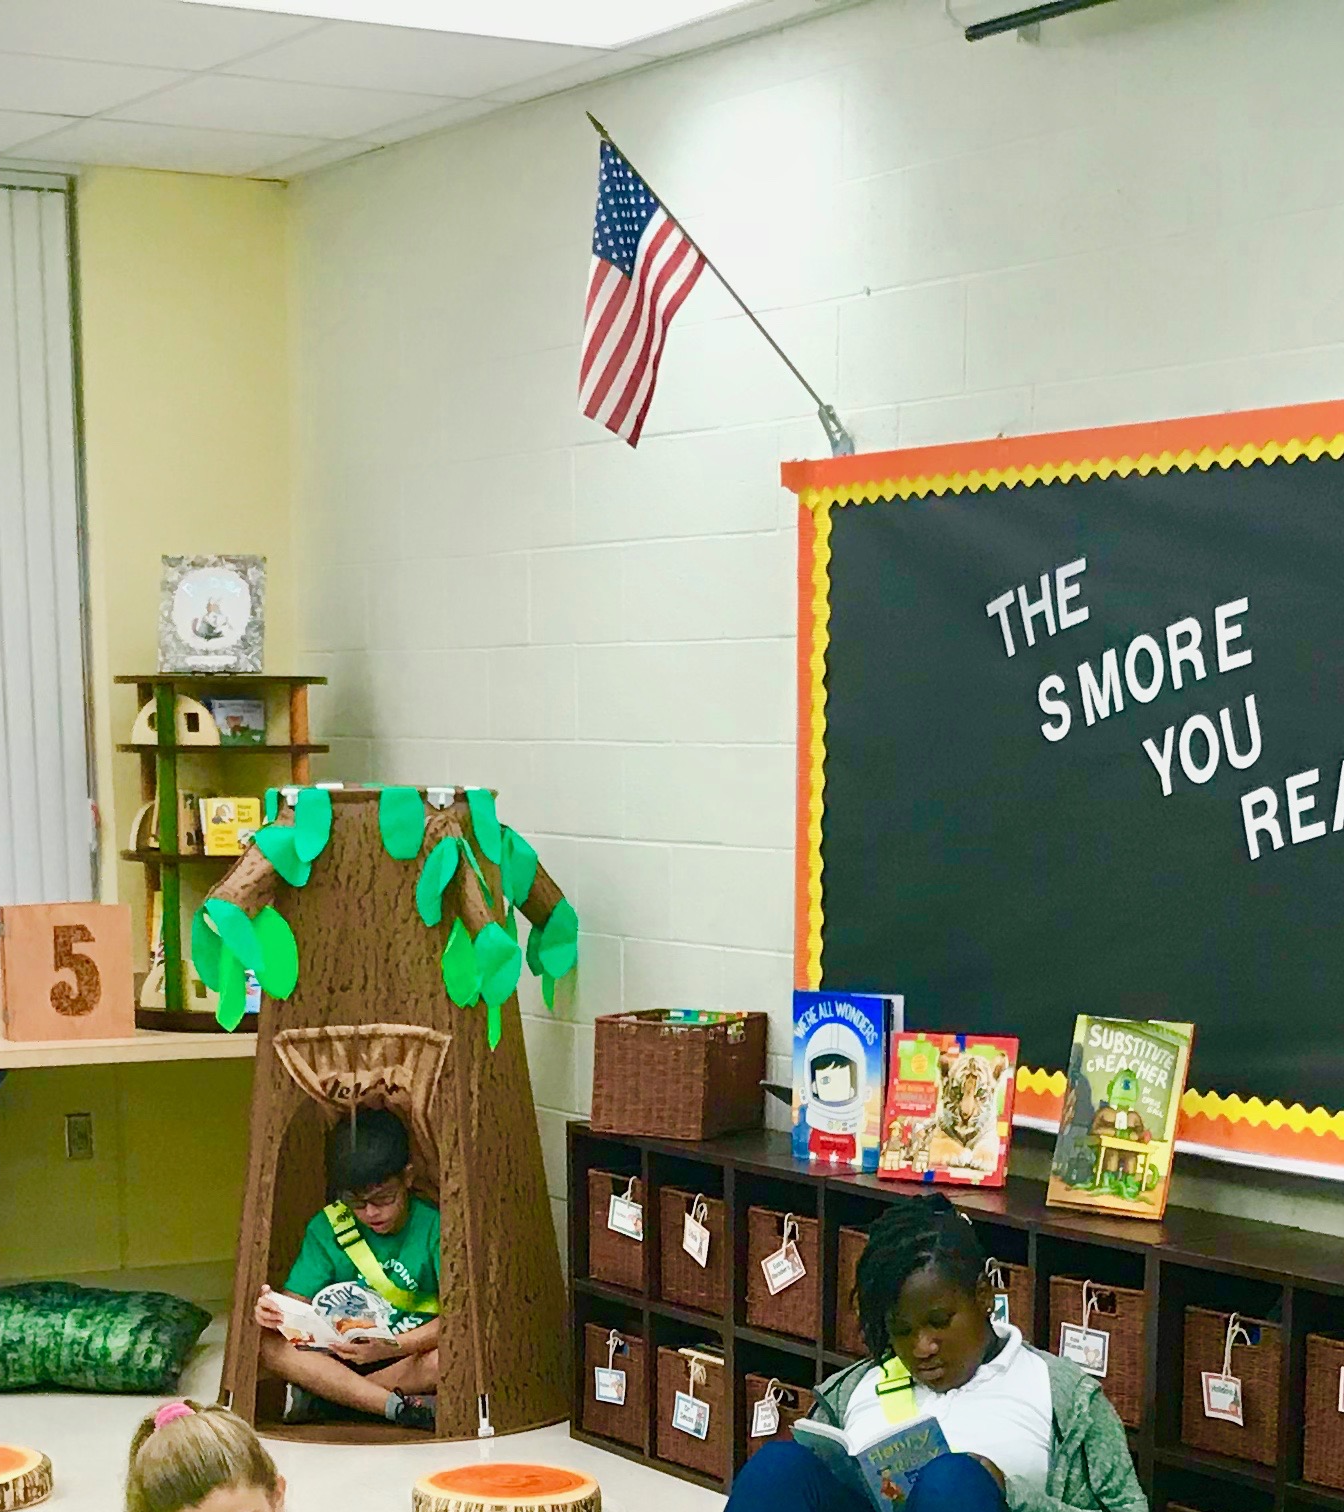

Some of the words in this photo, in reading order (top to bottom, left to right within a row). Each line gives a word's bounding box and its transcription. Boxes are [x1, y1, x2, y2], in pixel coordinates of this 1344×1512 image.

[985, 557, 1089, 658] THE
[1038, 597, 1253, 743] SMORE
[1142, 694, 1262, 797] YOU
[49, 924, 101, 1016] 5
[818, 1001, 834, 1020] ALL
[834, 1000, 878, 1046] WONDERS
[1088, 1023, 1175, 1070] SUBSTITUTE
[1086, 1055, 1169, 1089] CREACHER
[317, 1285, 364, 1315] Stink
